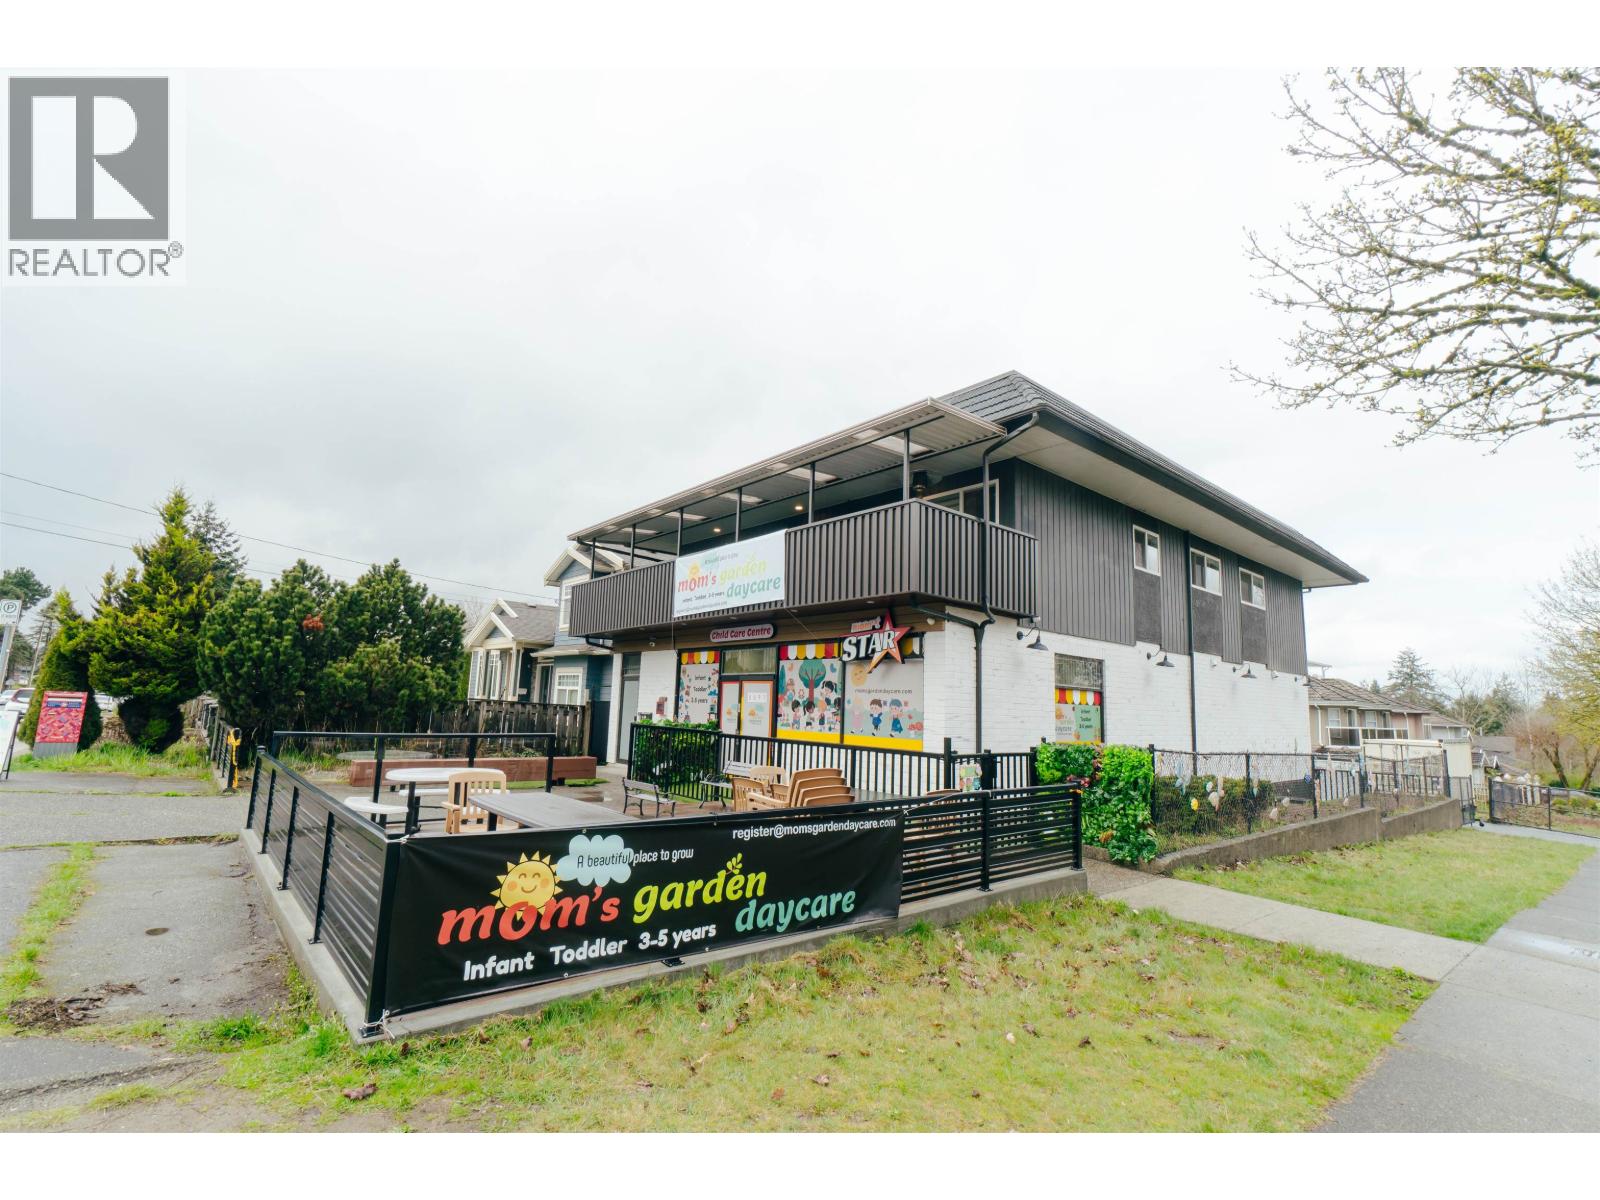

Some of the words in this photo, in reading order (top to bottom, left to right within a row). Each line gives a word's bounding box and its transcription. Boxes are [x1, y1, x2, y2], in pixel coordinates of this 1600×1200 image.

[678, 571, 717, 593] mom's
[719, 559, 767, 587] garden
[726, 576, 781, 599] daycare
[711, 630, 729, 640] Child
[730, 629, 746, 638] Care
[747, 627, 771, 637] Centre
[842, 630, 896, 662] STAR
[732, 818, 897, 841] register@momsgardendaycare.com
[577, 855, 584, 869] A
[587, 848, 633, 867] beautiful
[633, 849, 658, 866] place
[660, 849, 670, 861] to
[672, 848, 694, 863] grow
[437, 885, 621, 945] mom's
[632, 868, 767, 924] garden
[735, 890, 856, 933] daycare
[463, 951, 535, 981] Infant
[549, 937, 628, 965] Toddler
[638, 928, 669, 951] 3-5
[672, 923, 717, 949] years
